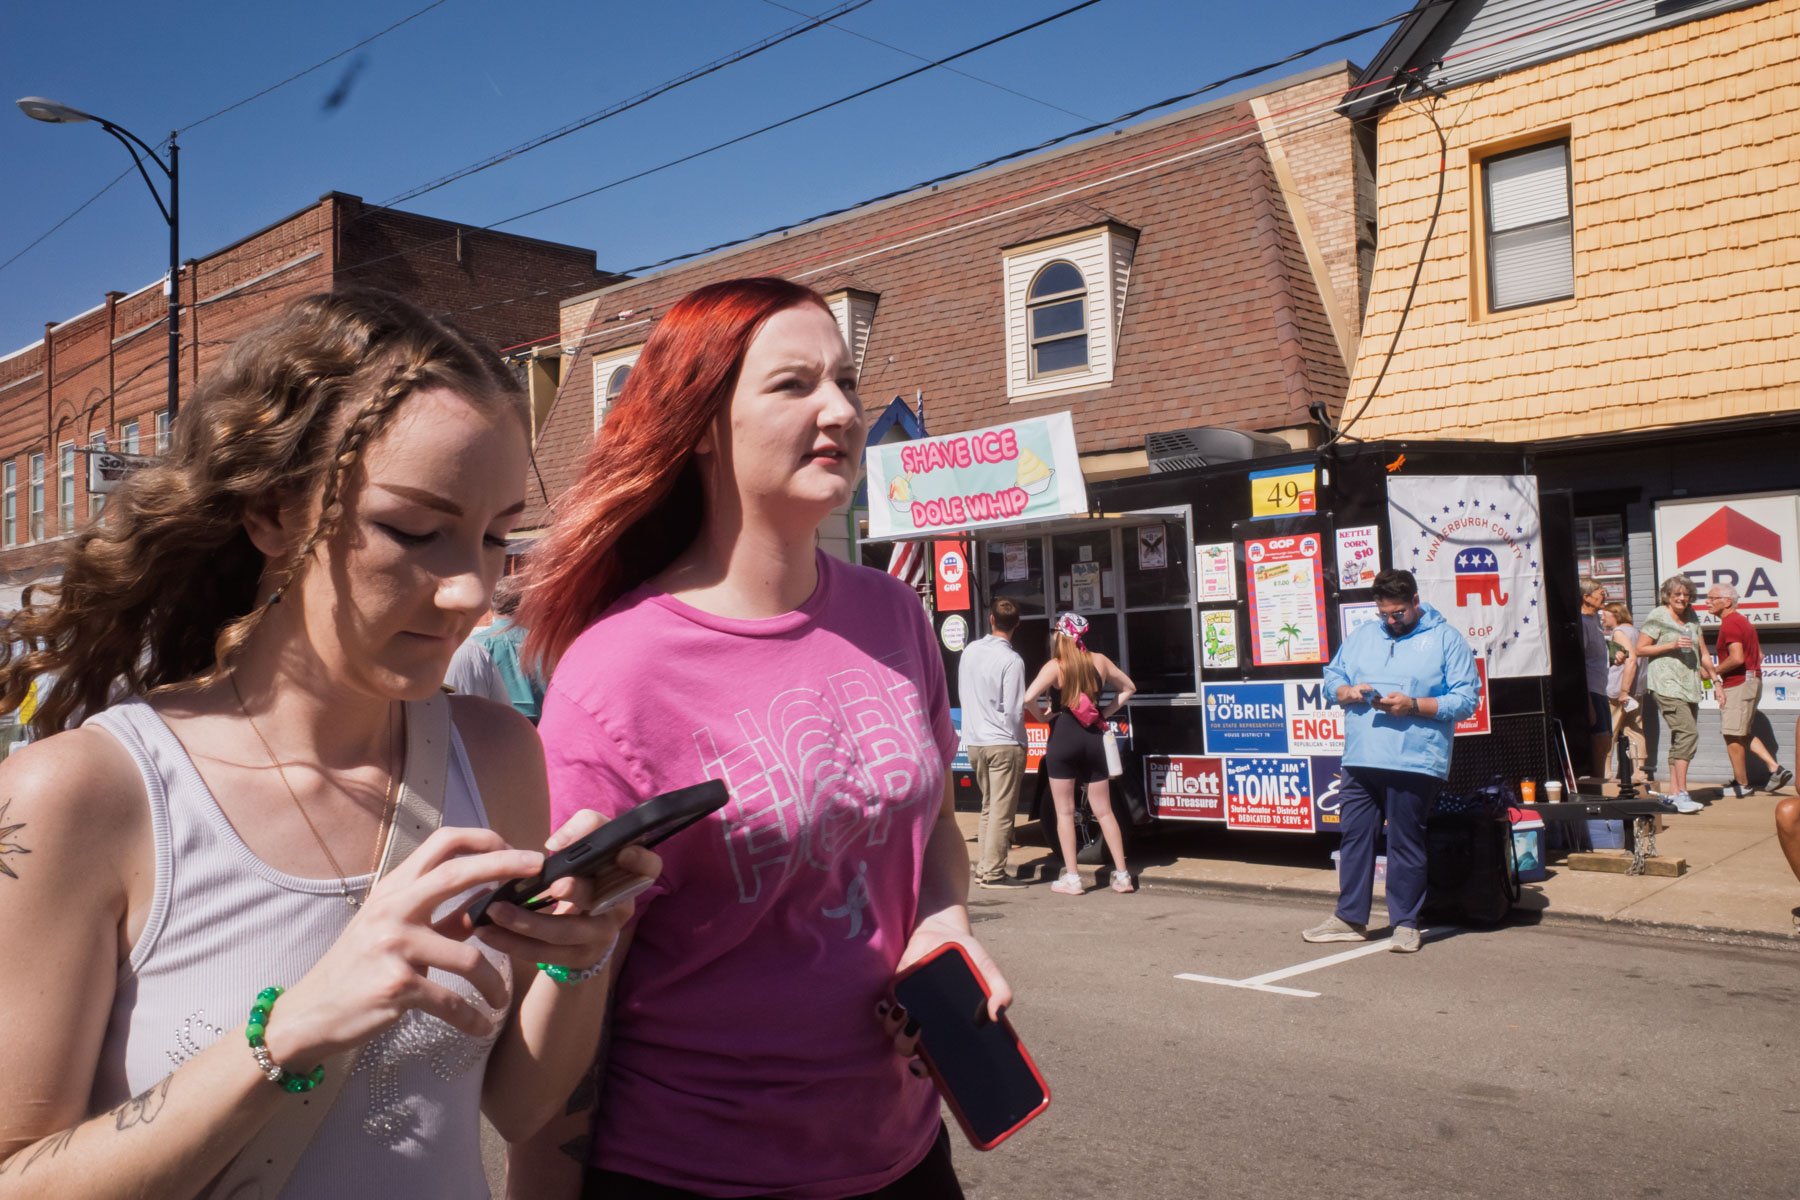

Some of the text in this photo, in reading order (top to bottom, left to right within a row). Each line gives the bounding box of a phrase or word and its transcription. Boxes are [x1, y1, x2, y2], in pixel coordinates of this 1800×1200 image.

[901, 428, 1019, 474] SHAVE ICE
[1267, 480, 1299, 508] 49
[911, 486, 1029, 528] DOLE WHIP
[1339, 528, 1371, 538] KETTLE
[1268, 538, 1295, 550] GOP
[1344, 539, 1368, 548] CORN
[1425, 517, 1523, 563] VANDERBURGH COUNTY
[1354, 547, 1374, 560] $10
[943, 583, 962, 592] GOP
[1468, 626, 1493, 637] GOP
[1217, 693, 1235, 704] TIM
[1217, 703, 1284, 720] O'BRIEN
[1150, 762, 1183, 771] Daniel
[1227, 763, 1250, 775] Re-Elect
[1280, 763, 1299, 773] JIM
[1151, 771, 1220, 794] Elliott
[1234, 774, 1302, 807] TOMES
[1153, 796, 1219, 809] State Treasurer
[1230, 804, 1246, 813] State
[1247, 805, 1270, 814] Senator
[1276, 806, 1298, 815] District
[1299, 807, 1308, 815] 49
[1238, 814, 1301, 825] DEDICATED TO SERVE
